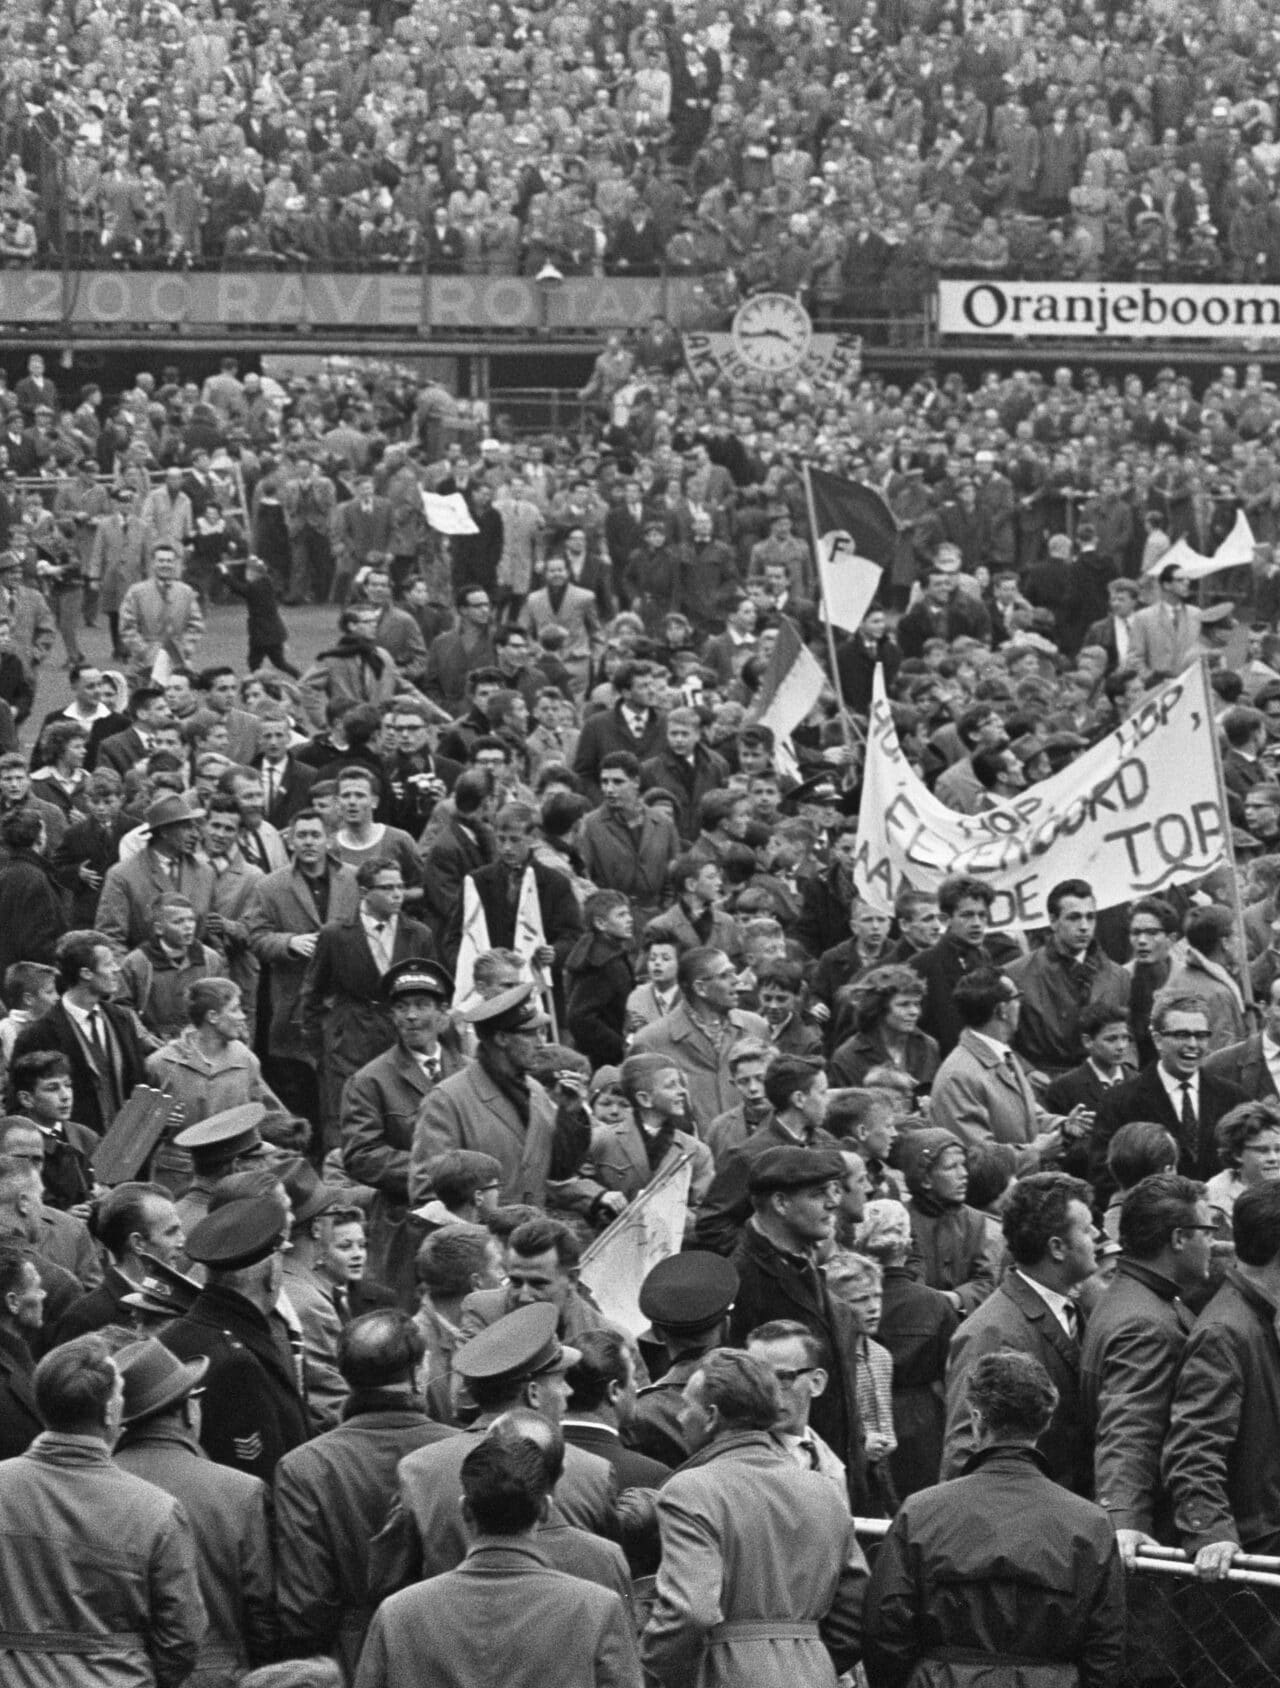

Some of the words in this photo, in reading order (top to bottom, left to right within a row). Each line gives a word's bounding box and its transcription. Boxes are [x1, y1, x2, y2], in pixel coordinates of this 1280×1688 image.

[218, 273, 533, 325] RAVERO
[828, 537, 851, 563] F
[987, 874, 1044, 928] DE
[1103, 801, 1222, 876] TOP
